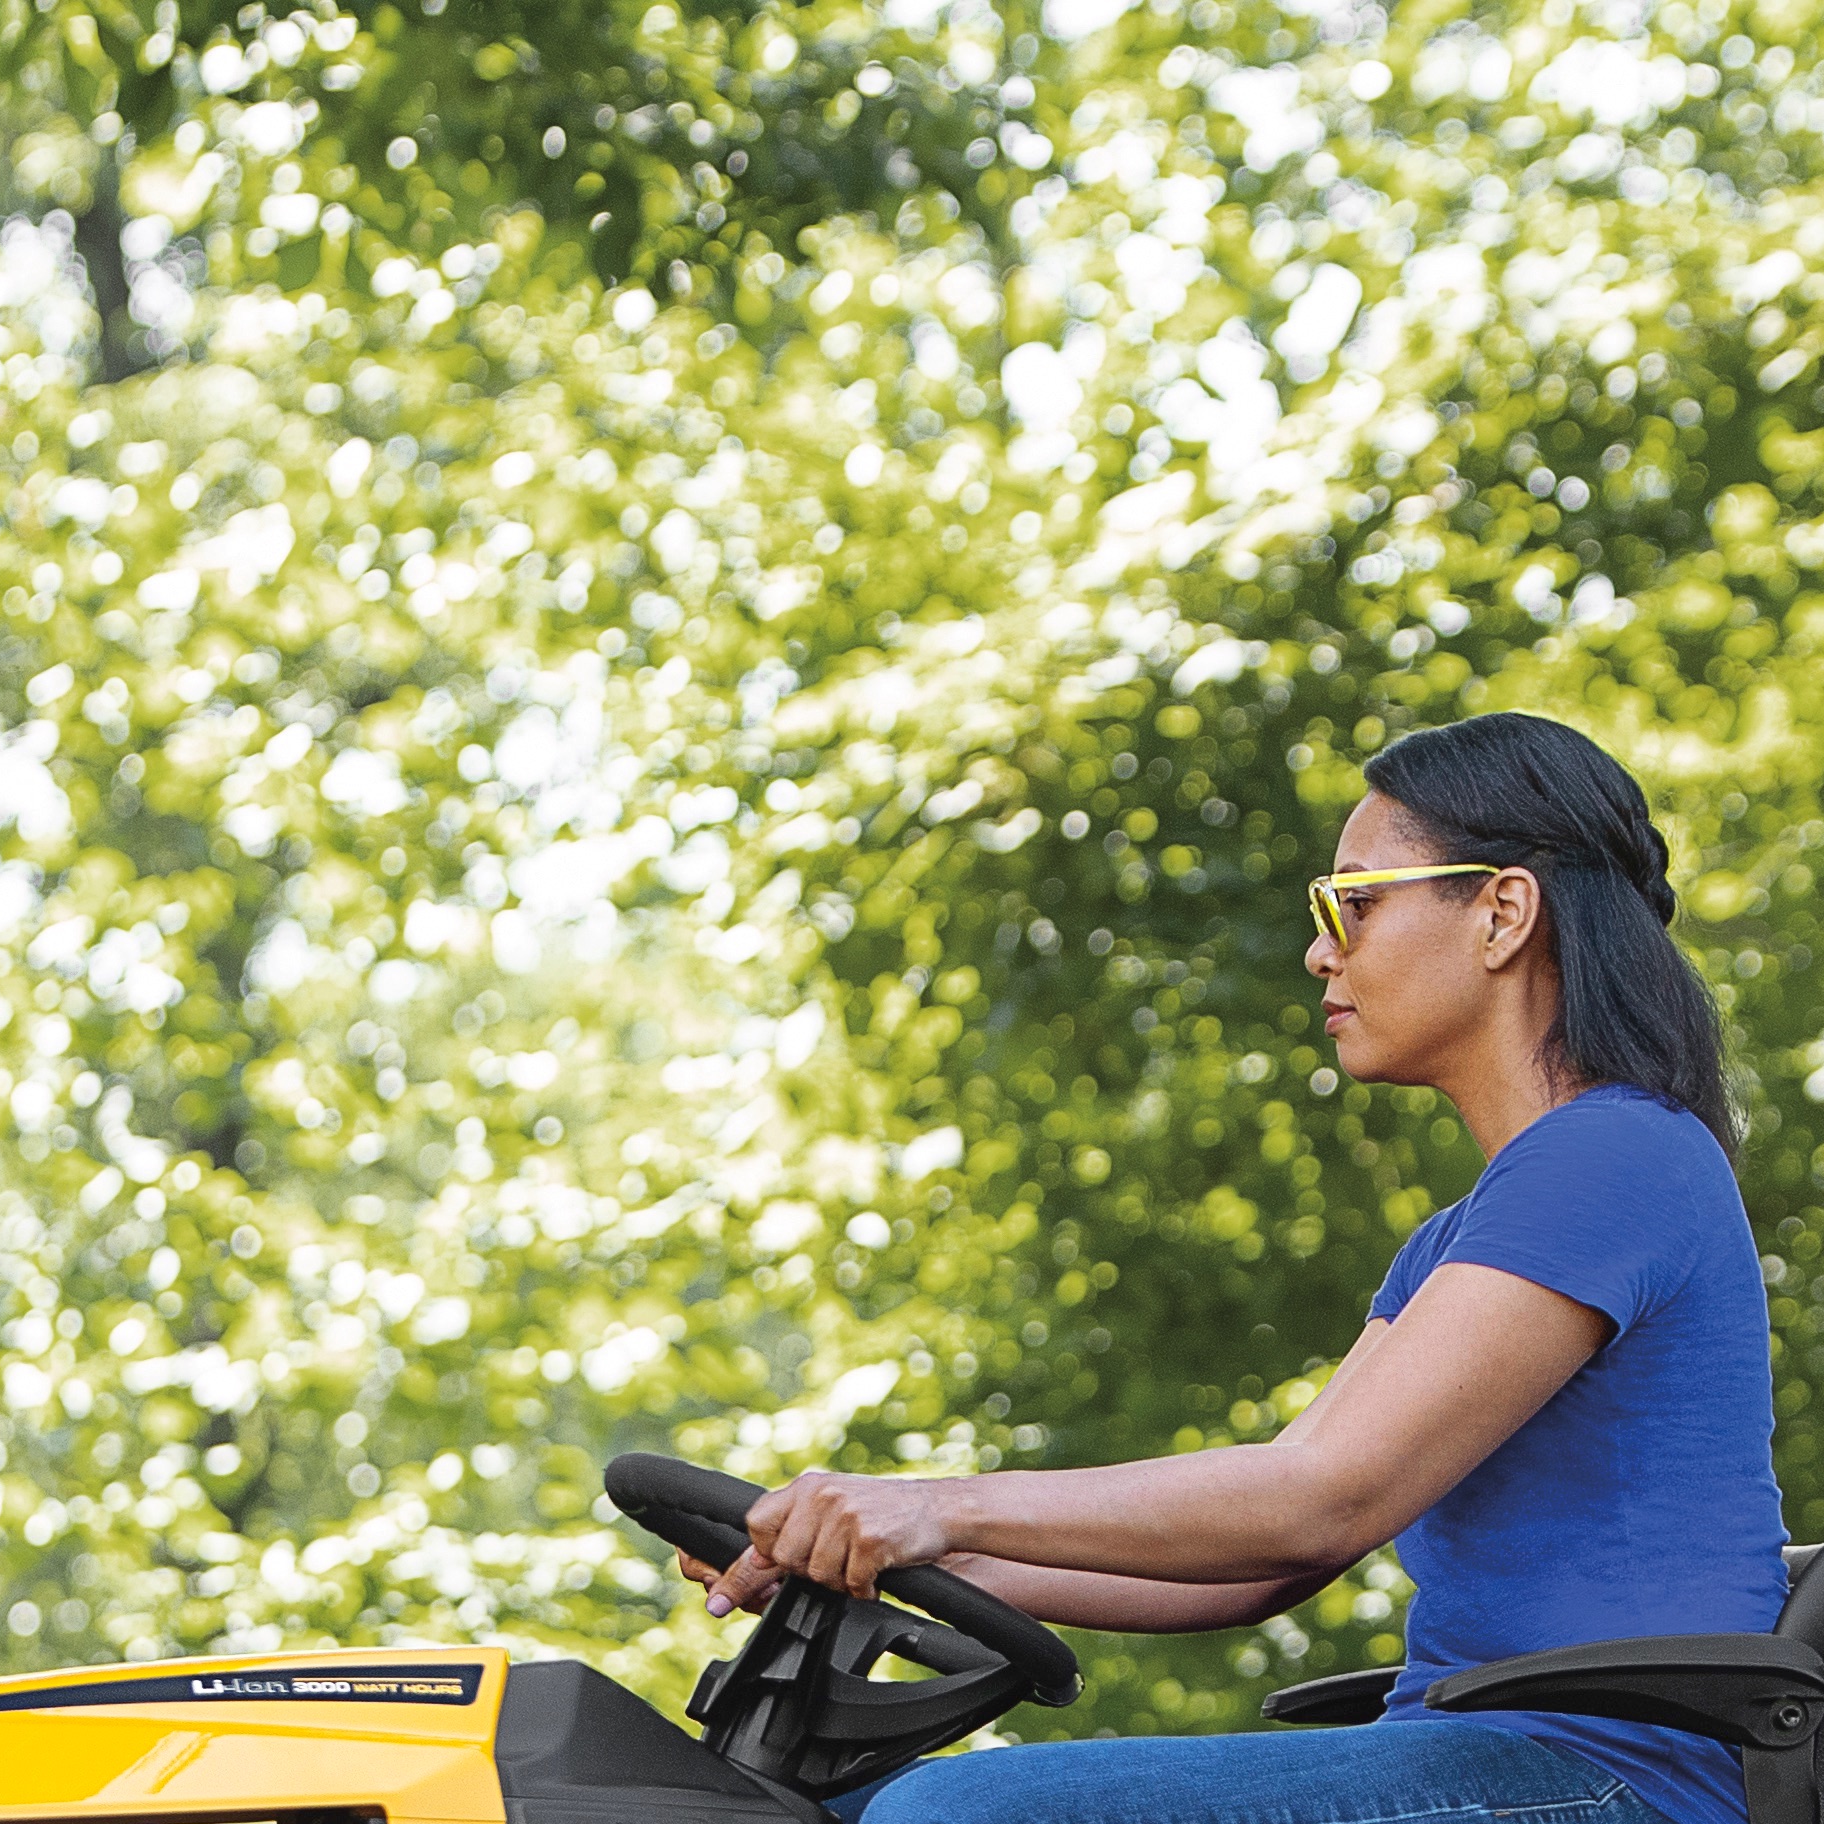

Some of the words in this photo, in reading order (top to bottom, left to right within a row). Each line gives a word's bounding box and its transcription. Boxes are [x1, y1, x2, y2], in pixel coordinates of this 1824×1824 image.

[292, 1681, 351, 1693] 3000
[353, 1684, 398, 1693] WATT
[403, 1684, 463, 1695] HOURS
